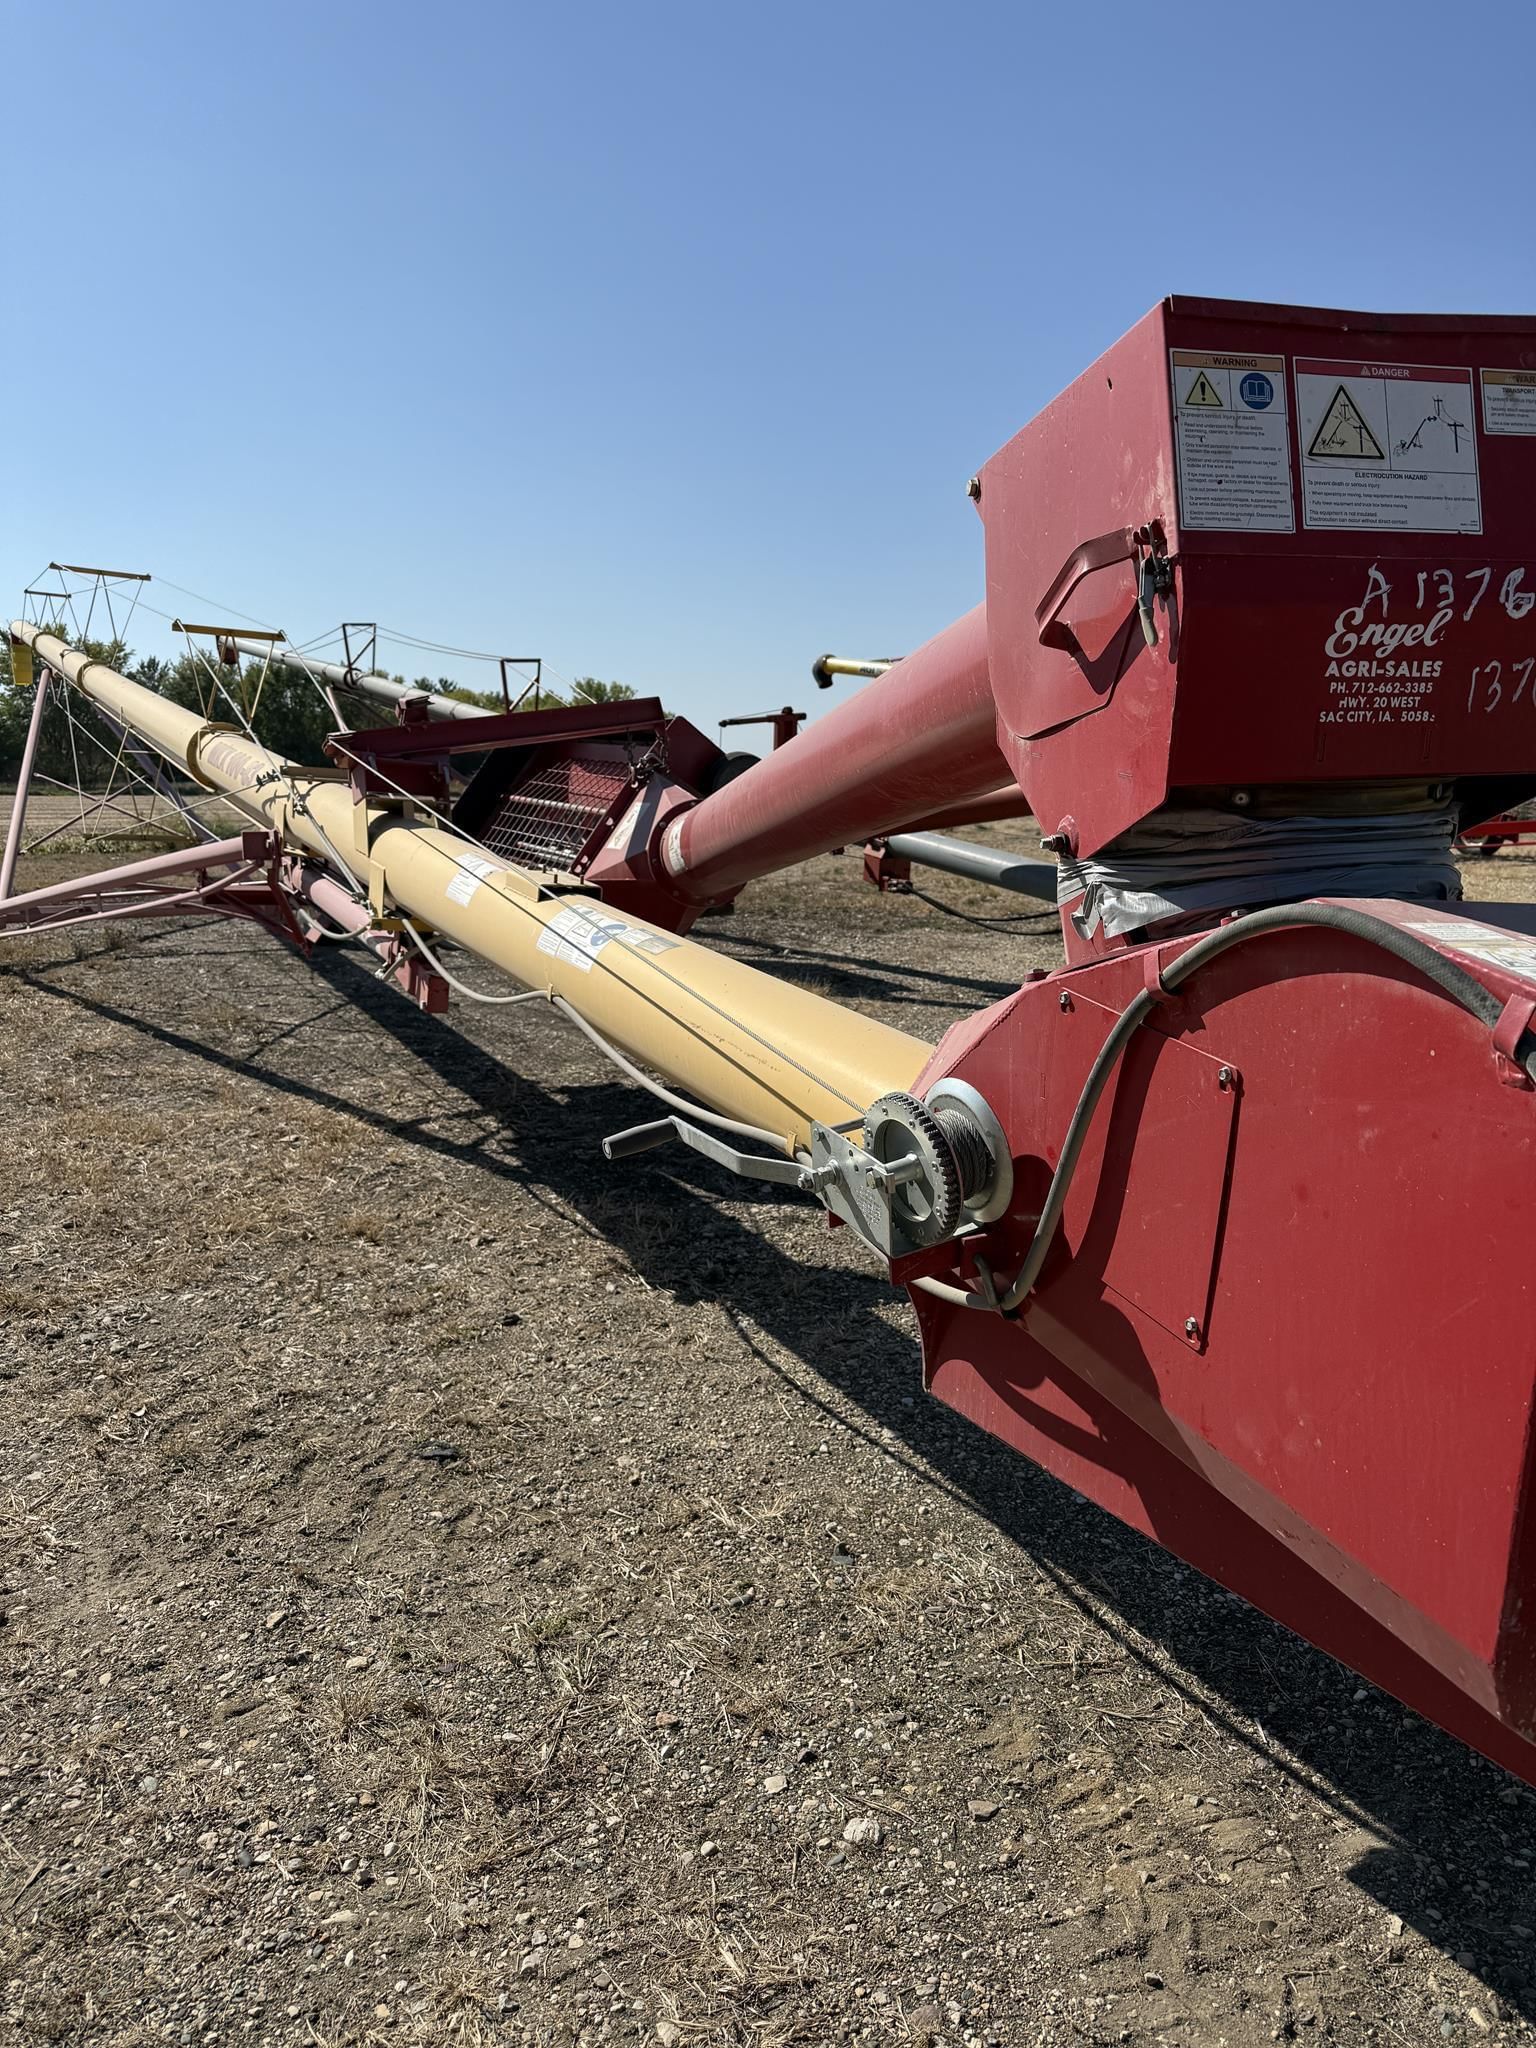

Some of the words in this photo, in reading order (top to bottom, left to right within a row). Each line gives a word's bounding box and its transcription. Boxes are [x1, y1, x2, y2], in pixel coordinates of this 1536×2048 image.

[1213, 356, 1258, 368] WARNING
[1372, 367, 1410, 378] DANGER
[1360, 562, 1393, 618] A
[1325, 606, 1453, 658] Engel
[1324, 660, 1443, 678] AGRI-SALES
[1330, 682, 1349, 694] PH.
[1352, 682, 1433, 694] 712-662-3385
[1468, 656, 1536, 712] 137
[1373, 697, 1388, 708] 20
[1390, 697, 1421, 708] WEST
[1320, 712, 1344, 722] SAC
[1346, 712, 1376, 724] CITY,
[1378, 712, 1394, 722] IA.
